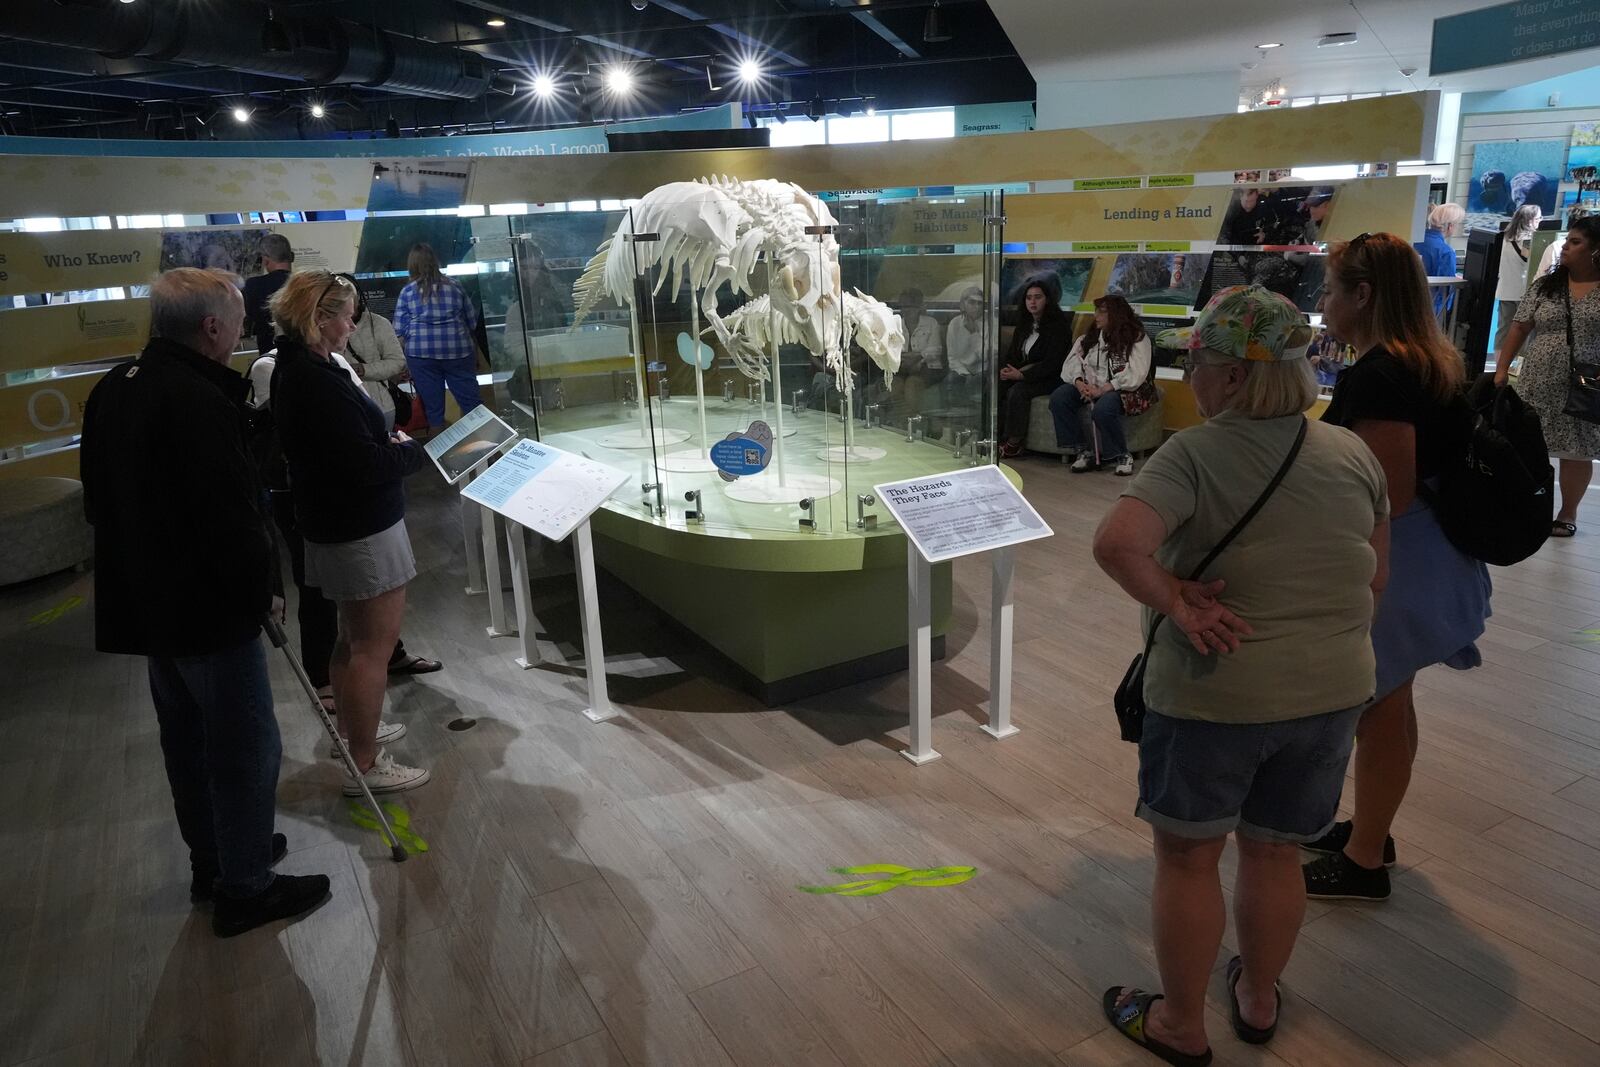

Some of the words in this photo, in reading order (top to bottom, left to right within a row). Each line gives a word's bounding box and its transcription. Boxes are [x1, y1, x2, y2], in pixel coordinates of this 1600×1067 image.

[1513, 24, 1538, 37] that
[550, 143, 608, 155] Lagoon
[914, 210, 937, 220] The
[1104, 208, 1159, 221] Lending
[1163, 209, 1171, 218] a
[1175, 206, 1212, 218] Hand
[914, 223, 969, 233] Habitats
[43, 255, 82, 268] Who
[86, 250, 141, 266] Knew?
[887, 489, 908, 497] The
[909, 480, 952, 493] Hazards
[893, 495, 920, 504] They
[921, 490, 947, 500] Face
